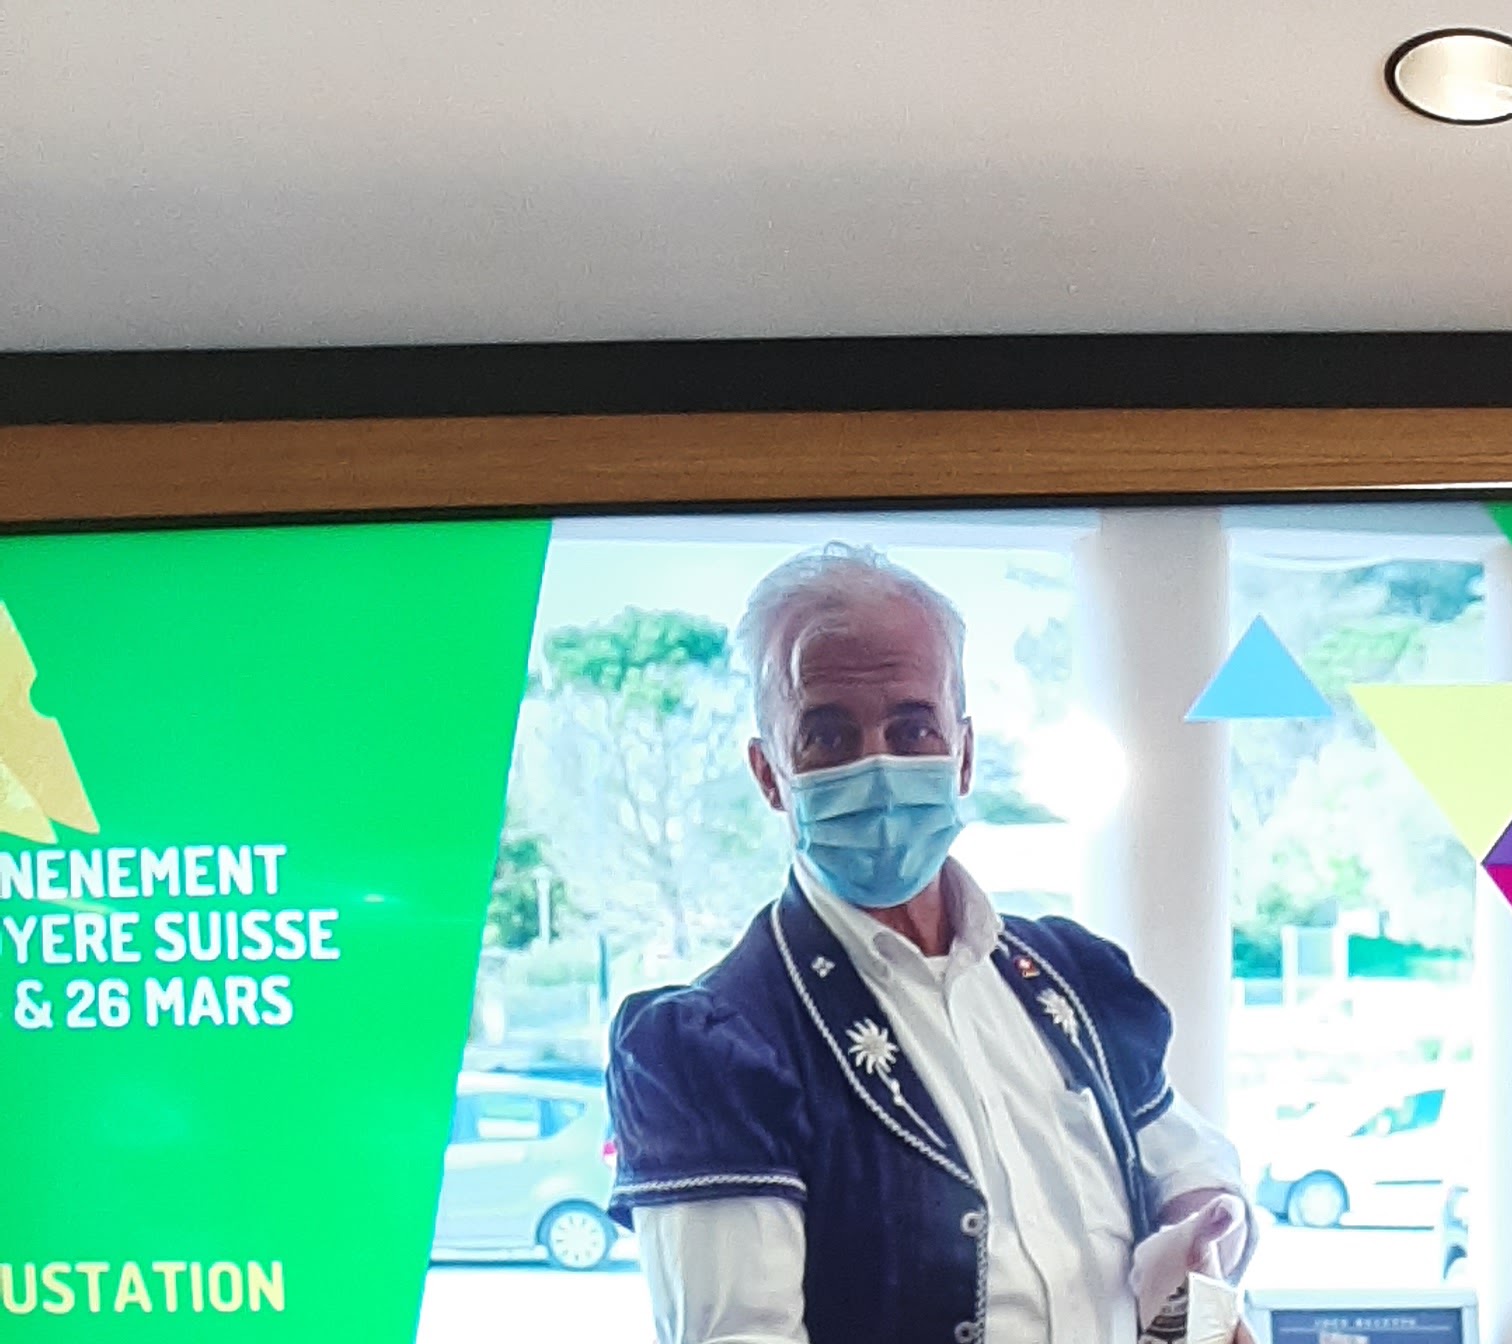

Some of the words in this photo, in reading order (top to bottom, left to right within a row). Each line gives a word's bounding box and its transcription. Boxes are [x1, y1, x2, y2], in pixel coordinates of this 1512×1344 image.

[154, 908, 341, 962] SUISSE
[14, 979, 53, 1029] &
[66, 978, 131, 1029] 26
[145, 975, 293, 1027] MARS
[0, 1260, 285, 1315] USTATION
